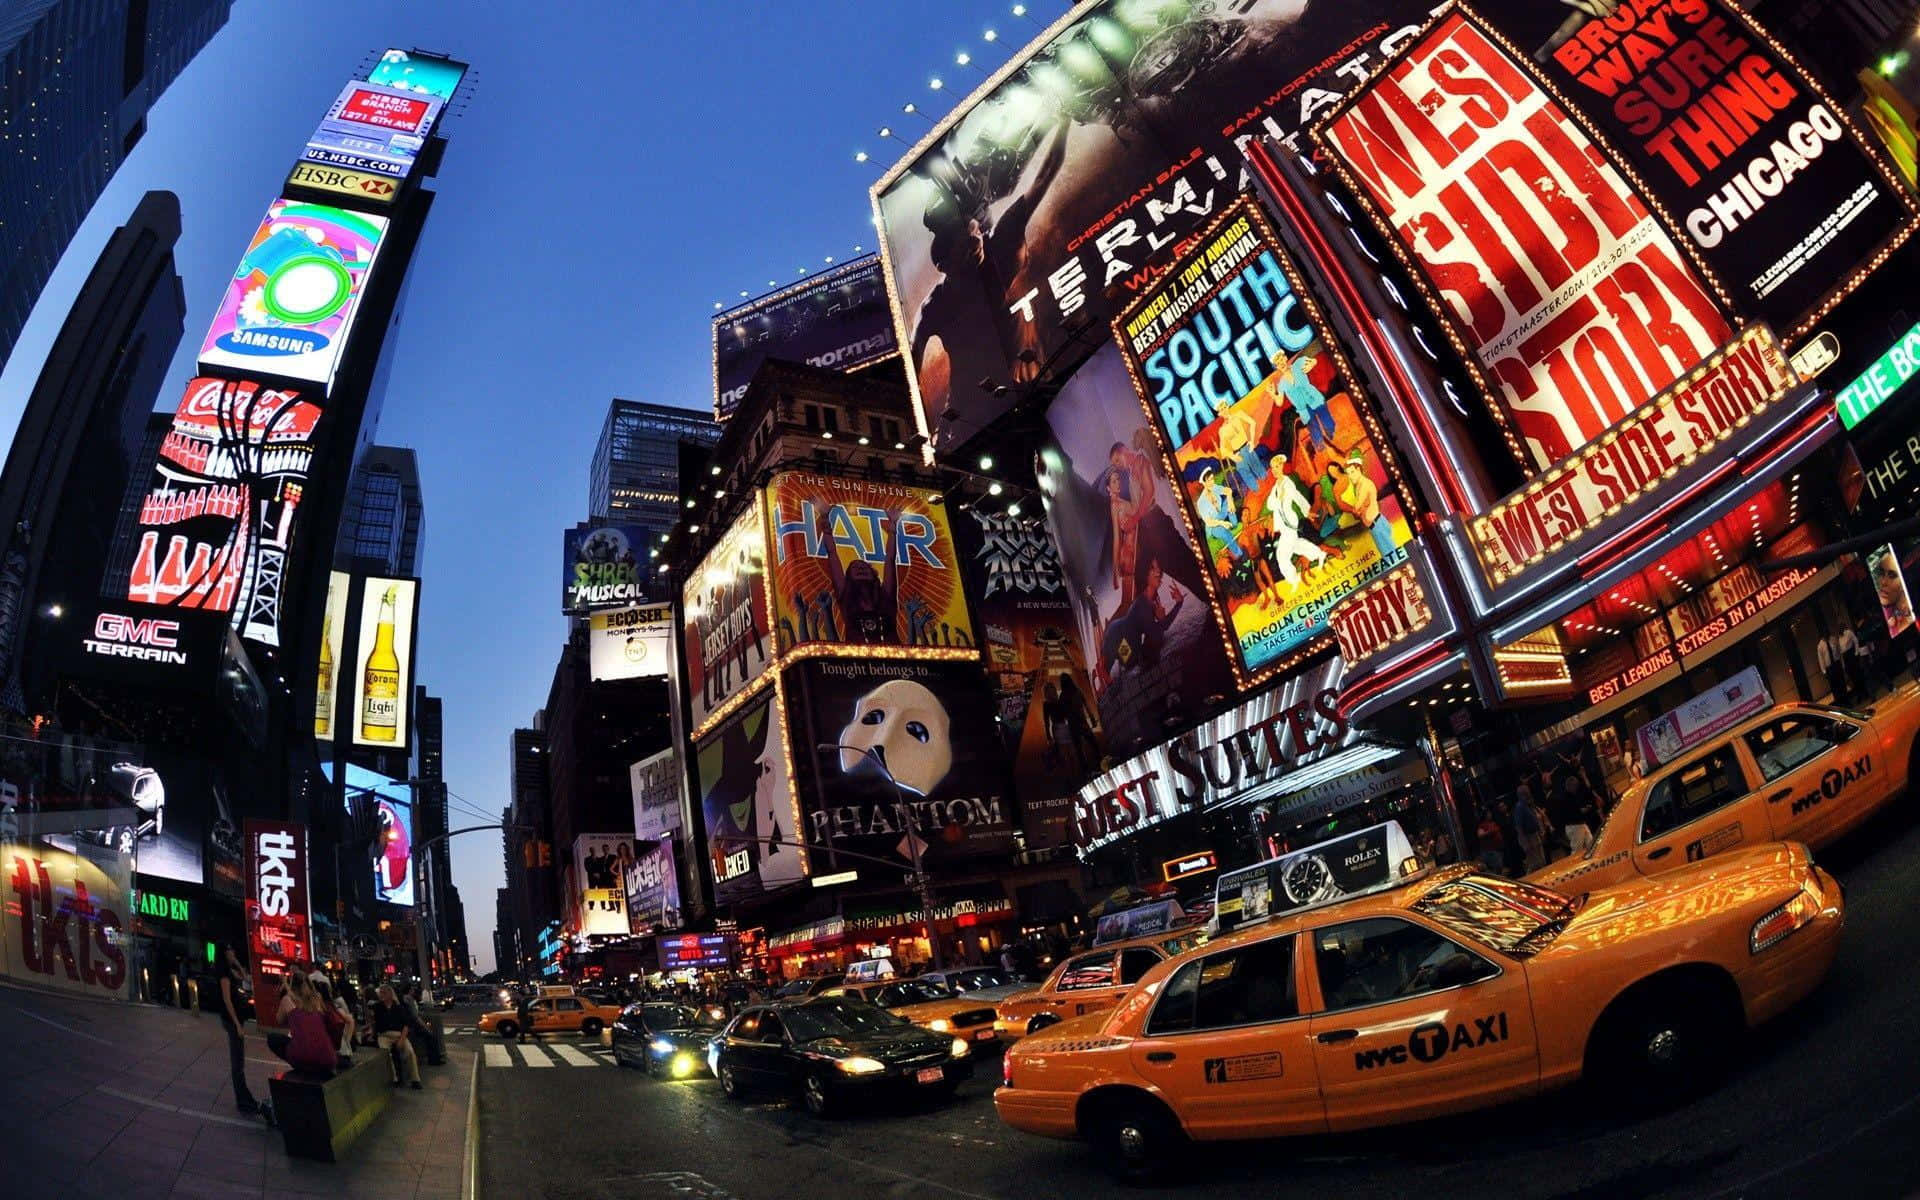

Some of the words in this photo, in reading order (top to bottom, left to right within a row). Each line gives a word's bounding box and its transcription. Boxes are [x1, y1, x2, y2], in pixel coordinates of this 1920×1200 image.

[1222, 107, 1262, 137] SAM
[1264, 21, 1391, 107] WORTHINGTON
[1577, 0, 1710, 98] WAY'S
[1614, 15, 1750, 136] SURE
[361, 98, 412, 114] BRANCH
[1331, 13, 1534, 218] WEST
[1644, 55, 1799, 188] THING
[293, 166, 359, 190] HSBC
[308, 149, 401, 174] US.HSBC.COM
[1686, 104, 1843, 248] CHICAGO
[1067, 183, 1155, 251] CHRISTIAN
[1156, 147, 1205, 185] BALE
[1400, 102, 1651, 345] SIDE
[765, 284, 829, 314] breathtaking
[1126, 291, 1171, 340] WINNER!
[1169, 282, 1178, 298] 7
[1178, 254, 1209, 288] TONY
[1205, 216, 1250, 265] AWARDS
[1132, 318, 1162, 355] BEST
[1161, 274, 1214, 328] MUSICAL
[1210, 231, 1261, 282] REVIVAL
[231, 329, 315, 354] SAMSUNG
[1144, 250, 1291, 403] SOUTH
[1482, 279, 1586, 362] TICKETMASTER.COM
[1158, 294, 1314, 450] PACIFIC
[1490, 242, 1743, 465] STORY
[1836, 364, 1895, 423] THE
[1888, 322, 1920, 382] BO
[721, 381, 751, 407] ne
[1491, 469, 1588, 566] WEST
[1584, 410, 1685, 510] SIDE
[1673, 335, 1778, 448] STORY
[1865, 450, 1908, 499] THE
[798, 475, 825, 487] THE
[832, 479, 862, 492] SUN
[868, 484, 913, 498] SHINE
[773, 499, 948, 570] HAIR
[1355, 550, 1377, 567] SHER
[573, 561, 639, 589] SHREK
[575, 583, 644, 604] MUSICAL
[983, 551, 1065, 600] AGE
[1241, 612, 1295, 651] LINCOLN
[1296, 579, 1354, 619] CENTER
[1352, 545, 1408, 586] THEATE
[83, 639, 187, 665] TERRAIN
[94, 612, 180, 649] GMC
[607, 625, 647, 637] MONAYS
[704, 616, 731, 667] JERSEY
[730, 598, 753, 642] BOYS
[1263, 632, 1289, 651] TAKE
[1287, 625, 1305, 639] THE
[1333, 579, 1413, 664] STORY
[1588, 677, 1620, 705] BEST
[1621, 648, 1674, 689] LEADING
[1675, 617, 1728, 657] ACTRESS
[1727, 609, 1745, 627] IN
[1746, 600, 1757, 615] A
[366, 671, 398, 685] Corona
[818, 662, 868, 679] Tonight
[868, 663, 914, 678] belongs
[367, 698, 394, 714] Light
[1167, 687, 1350, 804] SUITES
[1820, 755, 1873, 800] TAXI
[810, 796, 1006, 845] PHANTOM
[259, 831, 297, 918] tkts
[1344, 847, 1382, 867] ROLEX
[1355, 1043, 1408, 1070] NYC
[1408, 1012, 1509, 1063] TAXI
